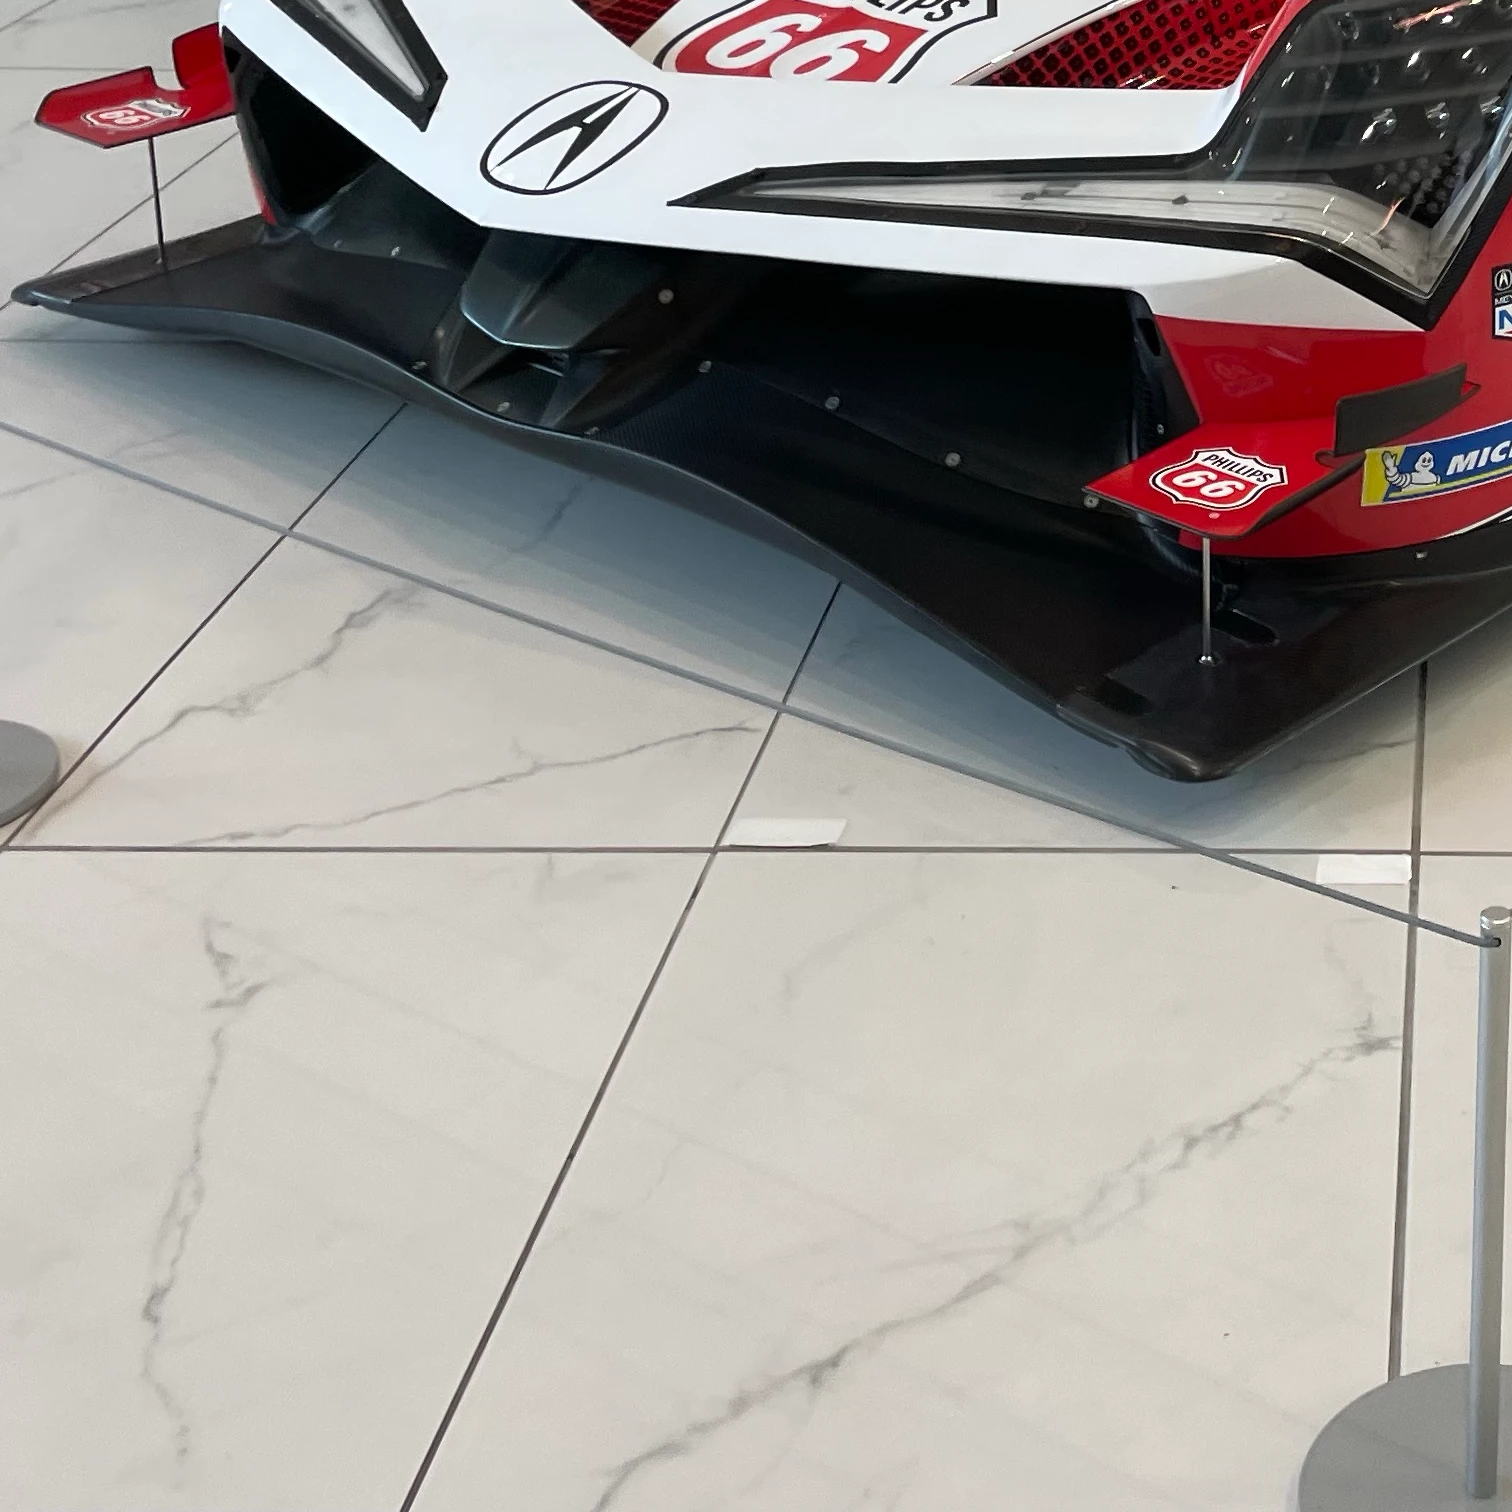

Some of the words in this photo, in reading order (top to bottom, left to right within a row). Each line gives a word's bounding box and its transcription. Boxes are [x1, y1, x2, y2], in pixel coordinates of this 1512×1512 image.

[705, 12, 890, 83] 66
[99, 110, 151, 124] 66
[1201, 453, 1274, 483] PHILLIPS
[1172, 470, 1246, 498] 66
